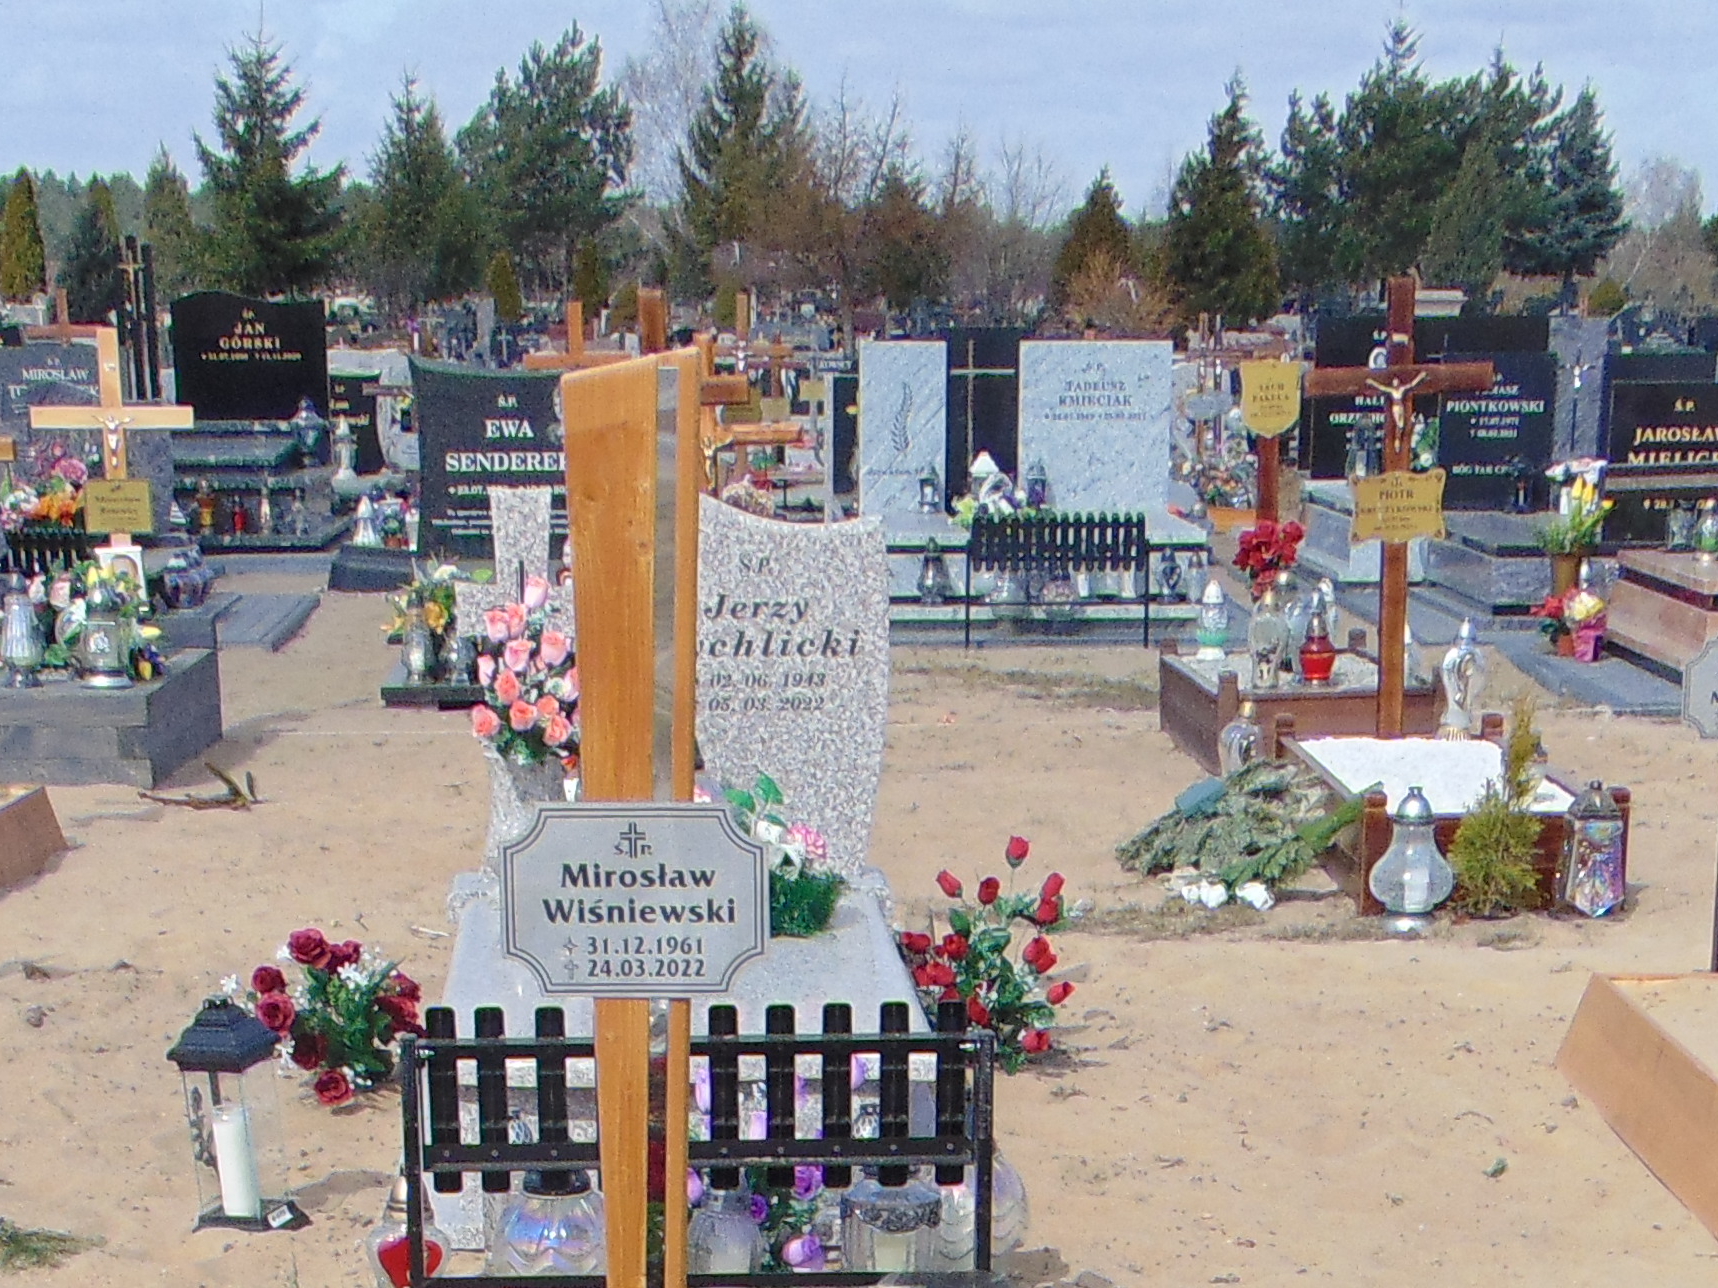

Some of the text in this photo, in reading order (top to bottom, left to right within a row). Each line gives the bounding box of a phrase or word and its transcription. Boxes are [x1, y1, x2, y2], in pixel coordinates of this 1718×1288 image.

[234, 322, 265, 335] JAN
[218, 335, 281, 349] GÓRSKI
[1065, 381, 1127, 392] TADEUSZ
[1058, 394, 1133, 407] KMIECIAK
[1447, 400, 1545, 413] PIONTKOWSKI
[485, 419, 534, 438] EWA
[704, 593, 809, 625] Jerzy
[699, 629, 860, 657] chlicki
[560, 863, 716, 888] Mirosław
[542, 898, 736, 924] Wiśniewski
[586, 936, 704, 955] 31.12.1961
[586, 959, 706, 978] 24.03.2022
